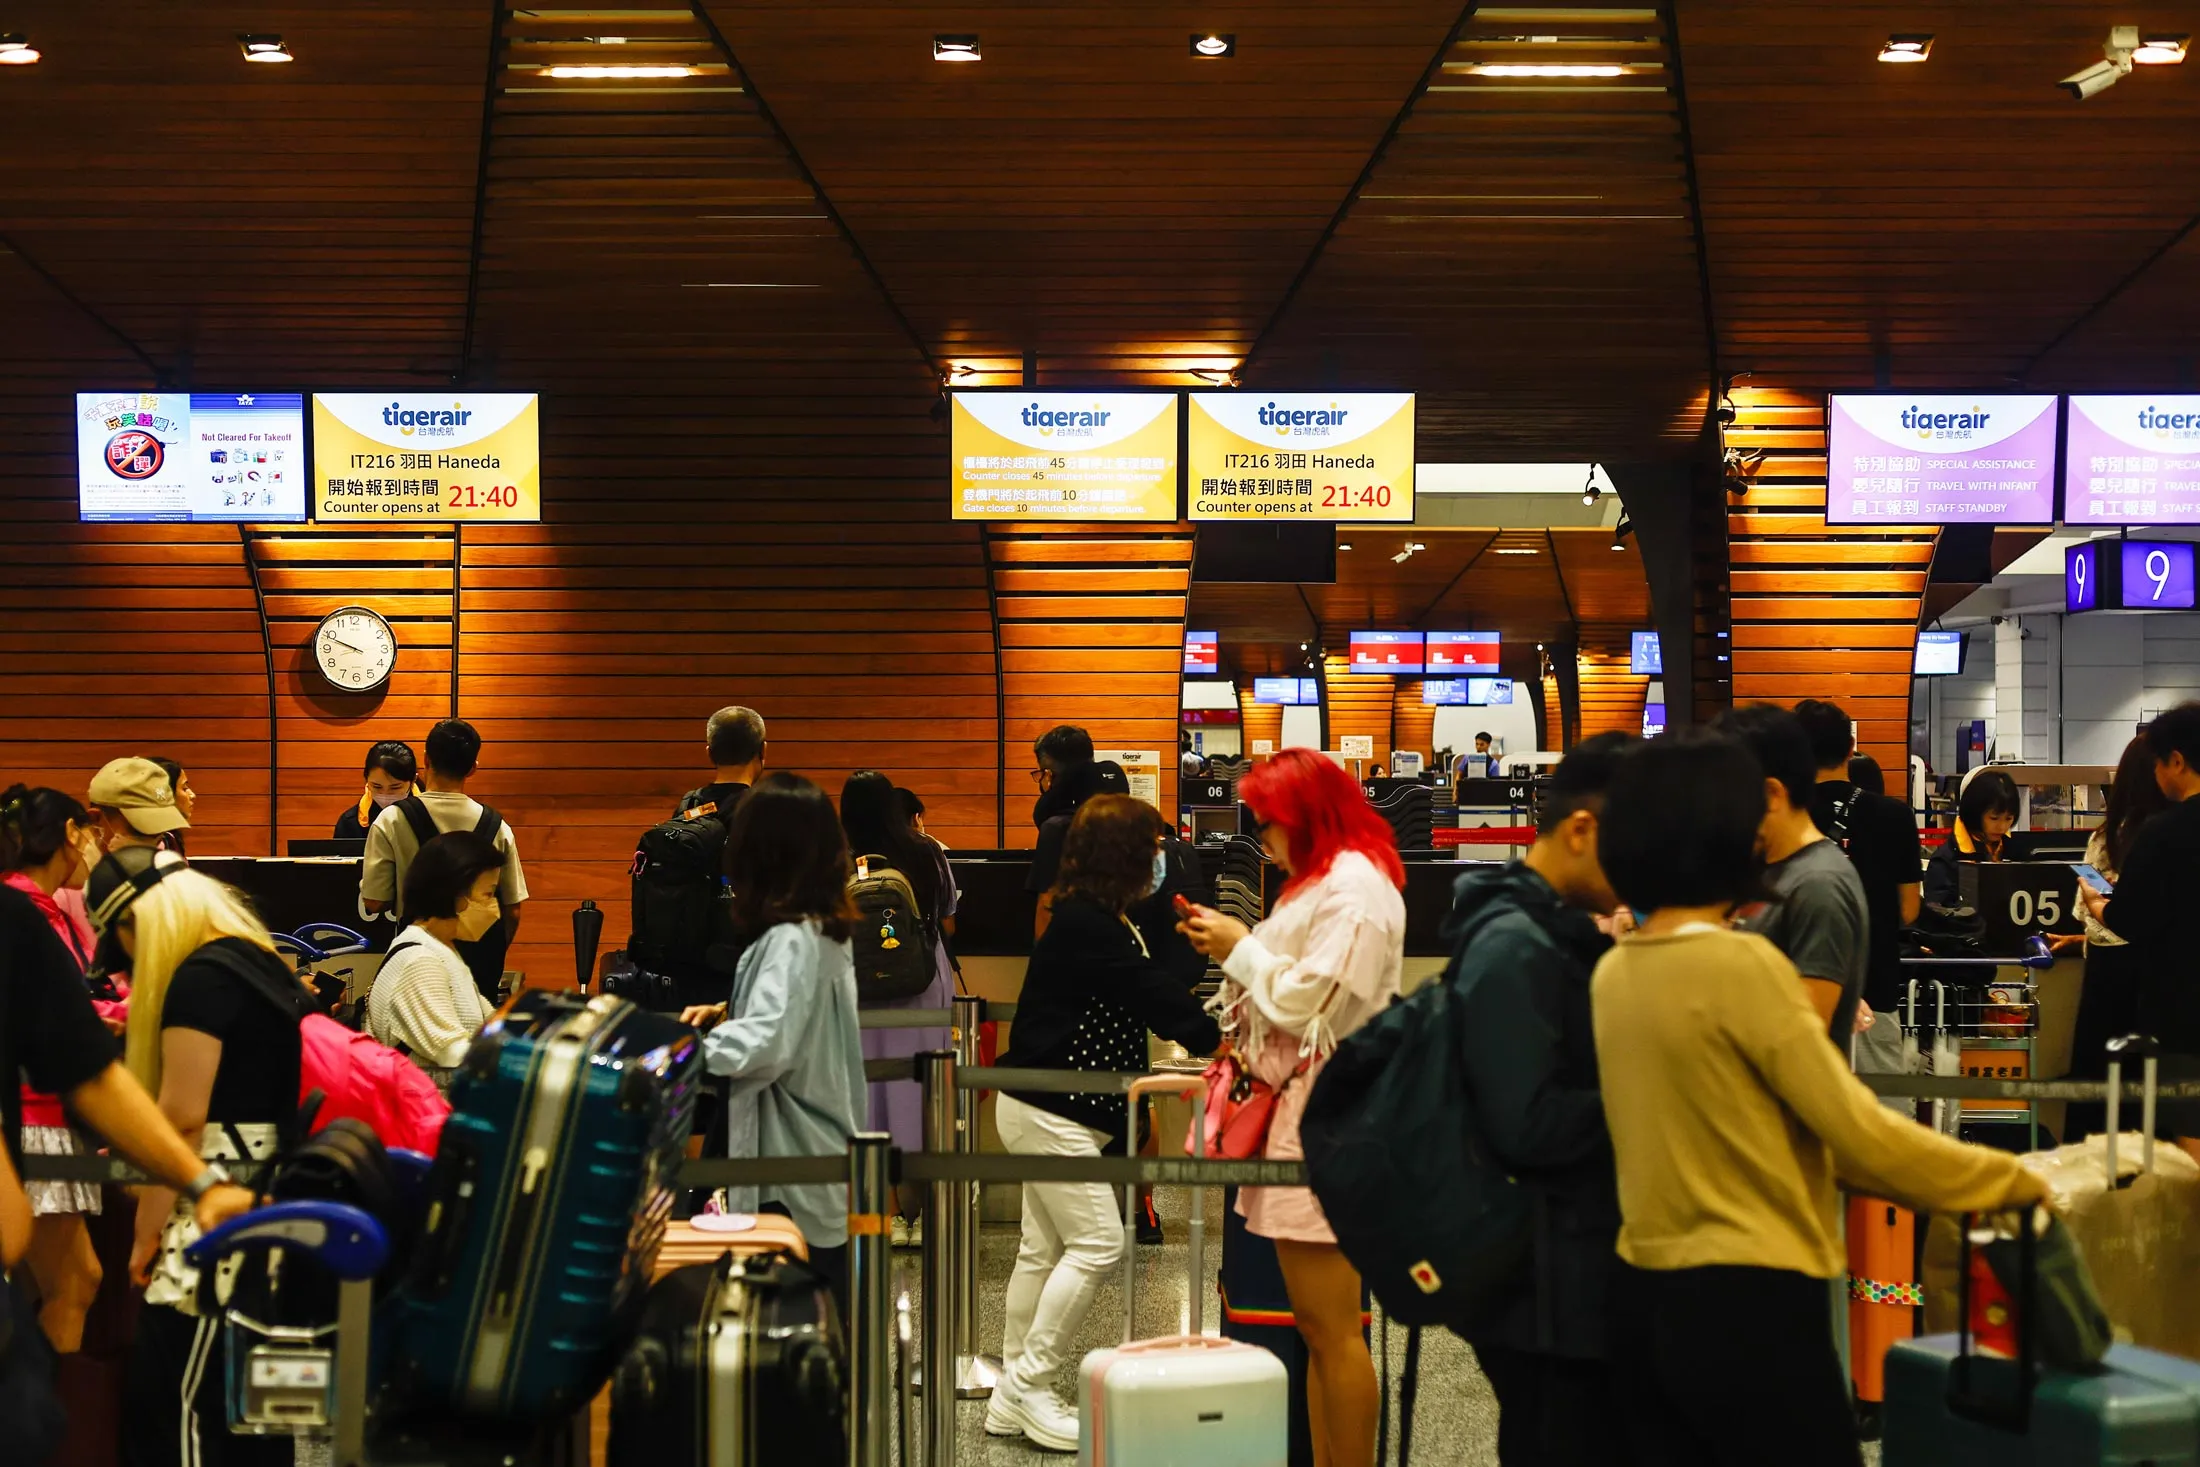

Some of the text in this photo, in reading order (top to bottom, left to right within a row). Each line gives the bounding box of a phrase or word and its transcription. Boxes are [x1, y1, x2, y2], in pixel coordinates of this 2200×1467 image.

[382, 402, 472, 436] tigerair
[1021, 402, 1111, 437] tigerair
[1258, 402, 1347, 436] tigerair
[1901, 405, 1990, 439] tigerair
[351, 454, 500, 469] IT216 羽田 Haneda
[1225, 454, 1375, 469] IT216 羽田 Haneda
[1927, 460, 2036, 469] SPECIAL ASSISTANCE
[1033, 472, 1044, 480] 45
[328, 479, 439, 496] 開始報到時間
[1202, 479, 1312, 496] 開始報到時間
[1927, 482, 2039, 491] TRAVEL WITH INFANT
[449, 486, 518, 508] 21:40
[1322, 486, 1391, 507] 21:40
[324, 501, 440, 515] Counter opens at
[1017, 504, 1028, 512] 10
[1197, 501, 1313, 515] Counter opens at
[1925, 504, 2007, 513] STAFF STANDBY
[2074, 553, 2086, 604] 9
[2145, 550, 2170, 601] 9
[337, 619, 344, 628] 11
[350, 616, 360, 625] 12
[376, 630, 384, 639] 2
[323, 644, 331, 653] 9
[381, 645, 388, 654] 3
[328, 658, 336, 667] 8
[376, 659, 384, 667] 4
[340, 669, 347, 679] 7
[352, 672, 360, 682] 6
[367, 669, 374, 678] 5
[1208, 786, 1223, 797] 06
[1509, 787, 1524, 798] 04
[2009, 890, 2060, 926] 05
